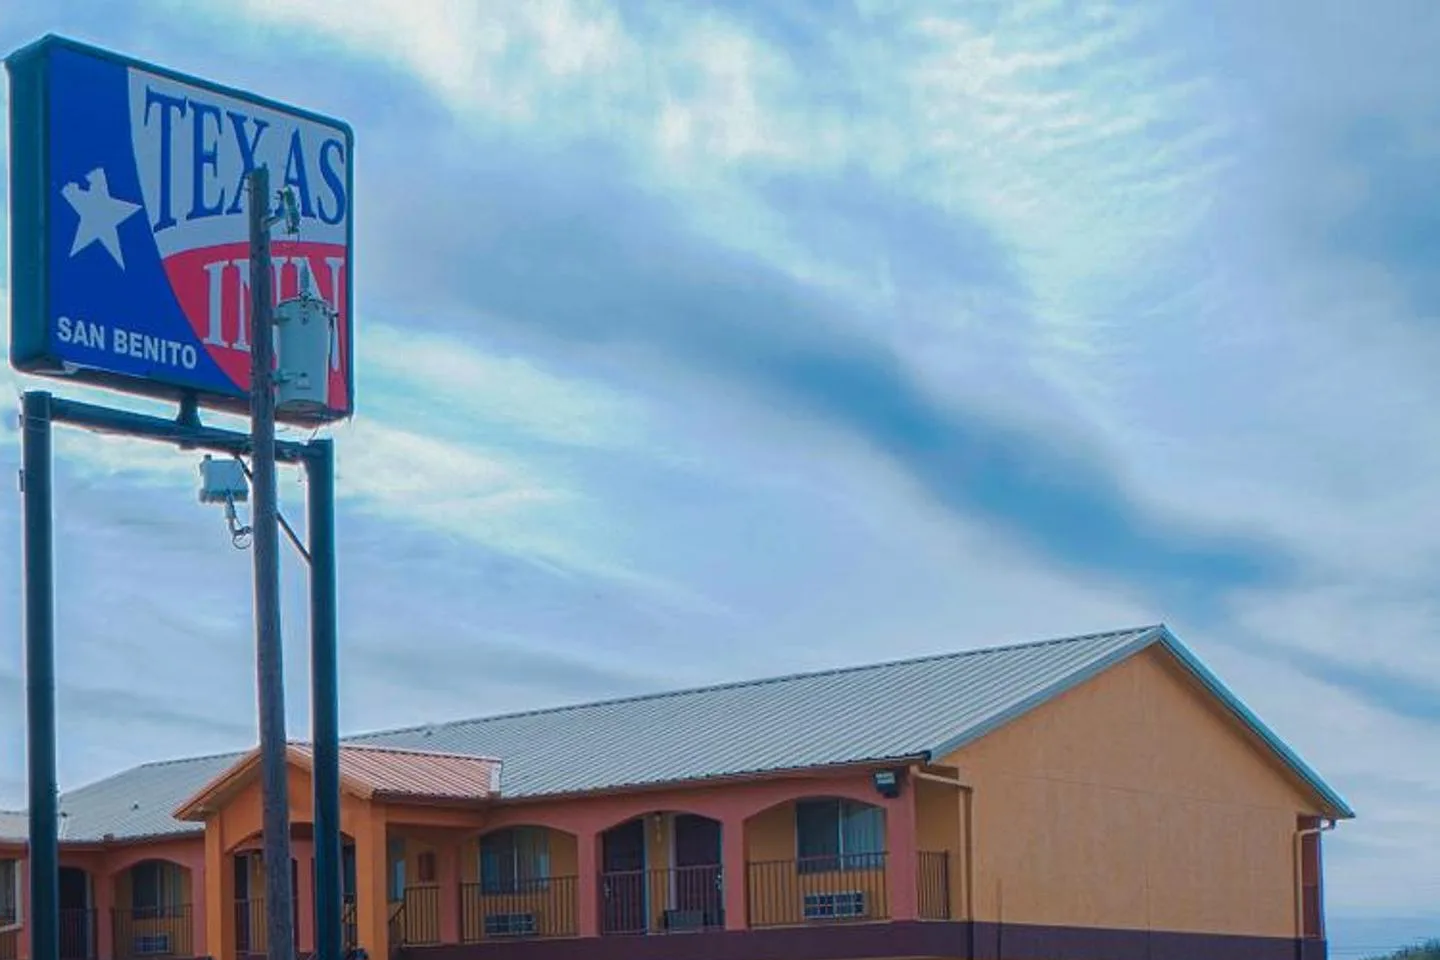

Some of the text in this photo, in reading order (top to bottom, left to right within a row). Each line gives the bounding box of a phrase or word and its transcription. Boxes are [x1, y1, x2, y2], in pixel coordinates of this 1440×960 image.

[144, 84, 346, 232] TEXAS
[57, 316, 197, 370] SAN BENITO
